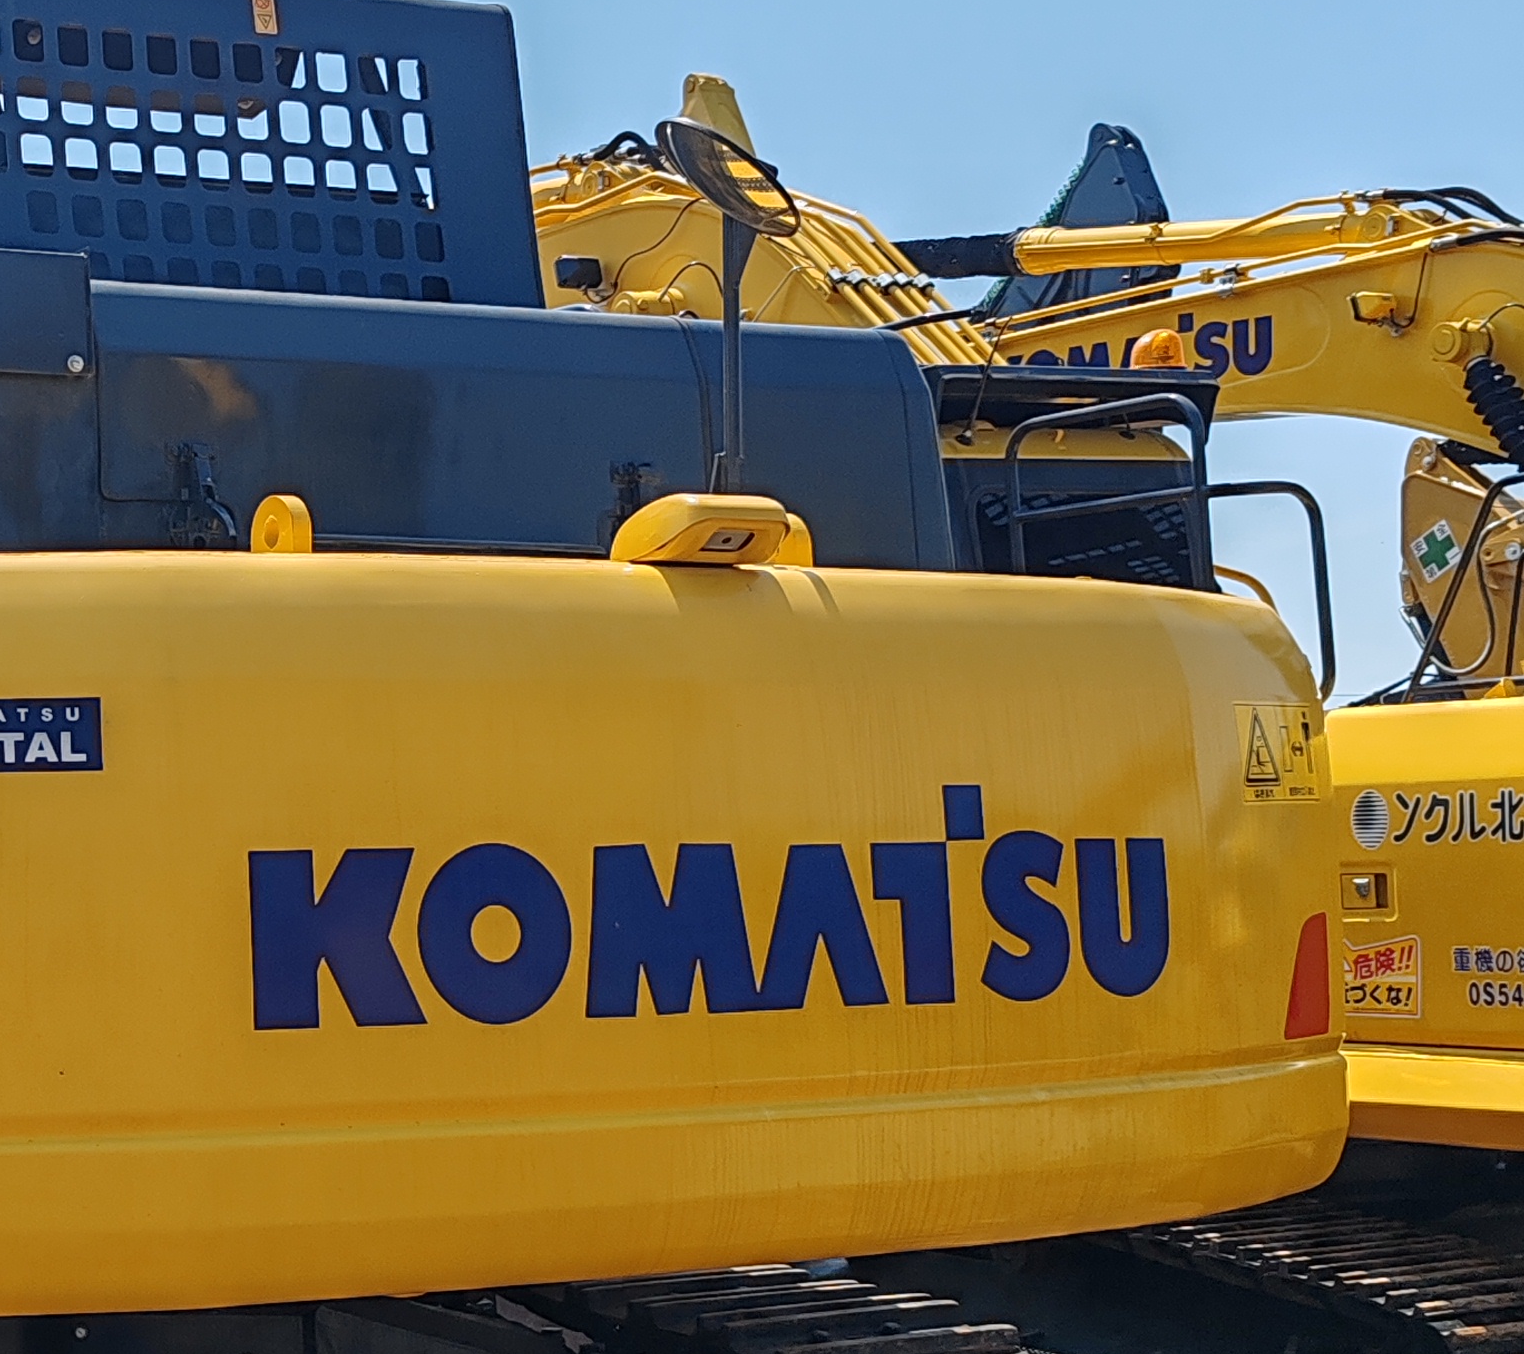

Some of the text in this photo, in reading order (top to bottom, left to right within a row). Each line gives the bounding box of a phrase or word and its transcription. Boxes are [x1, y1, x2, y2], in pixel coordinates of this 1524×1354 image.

[248, 784, 1170, 1031] KOMATSU
[1345, 983, 1413, 1007] づくな!
